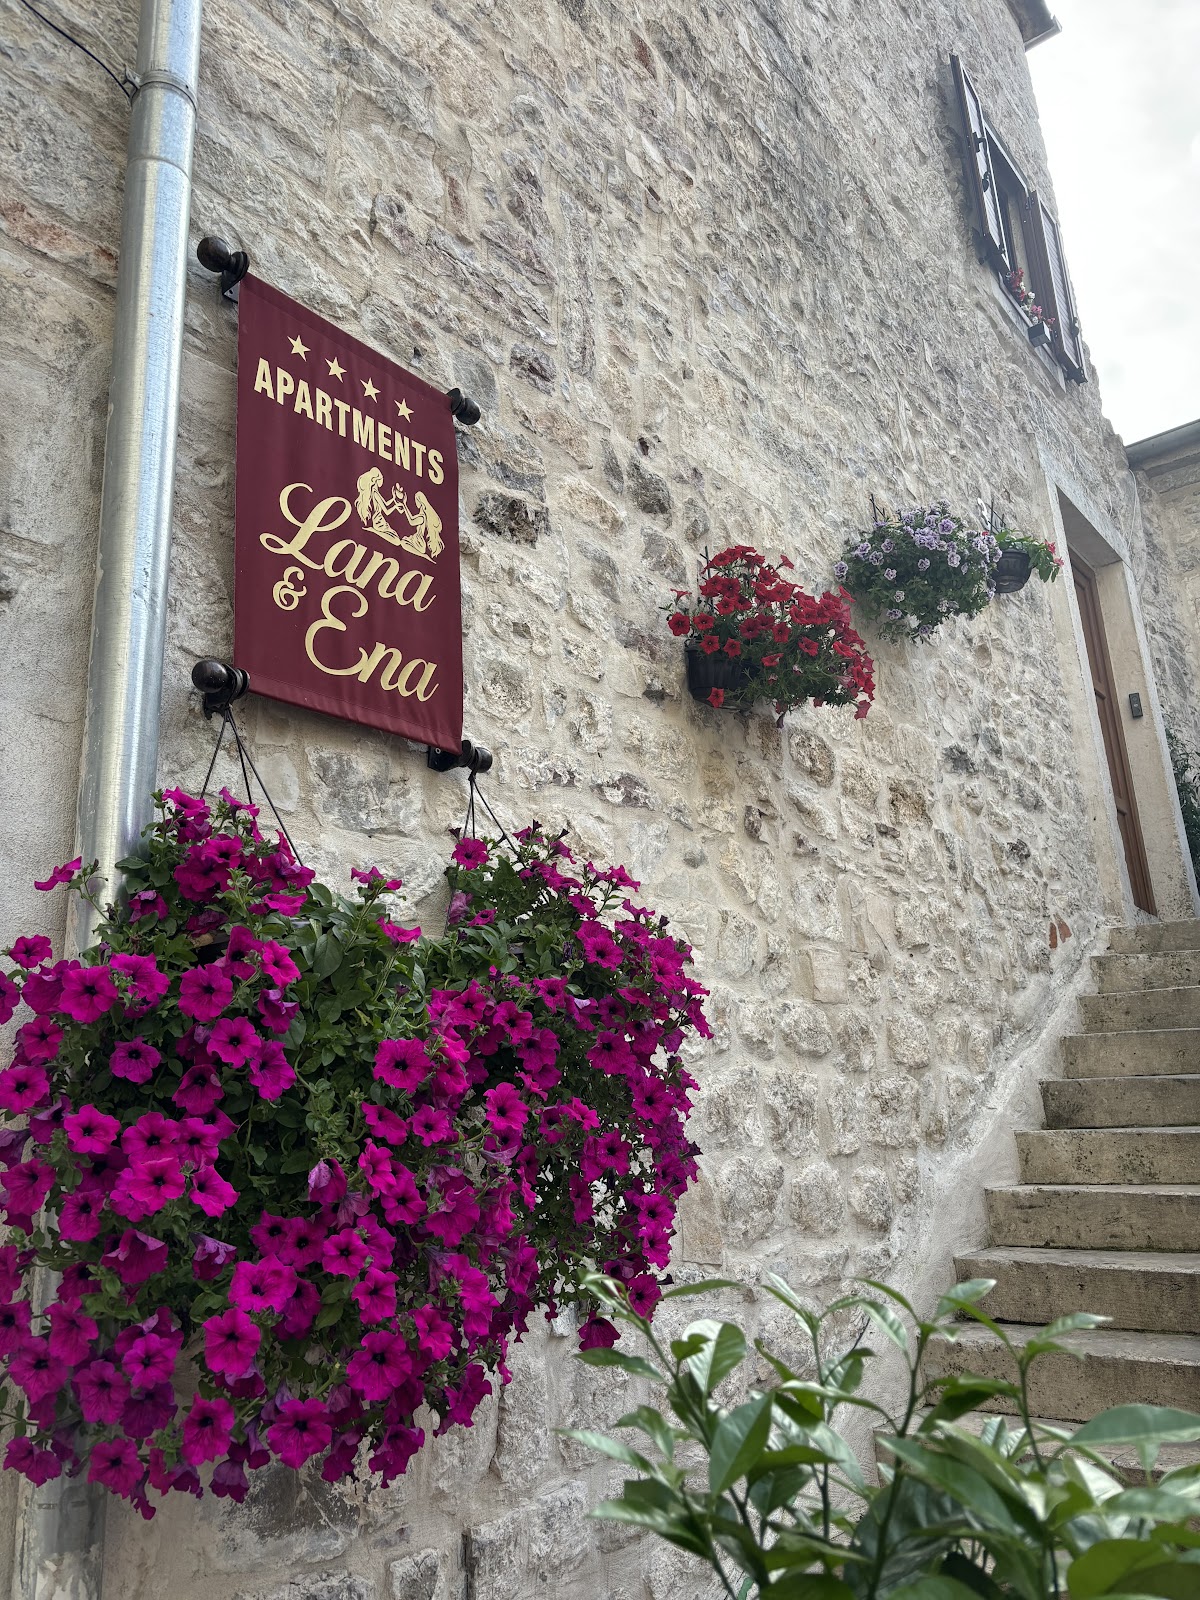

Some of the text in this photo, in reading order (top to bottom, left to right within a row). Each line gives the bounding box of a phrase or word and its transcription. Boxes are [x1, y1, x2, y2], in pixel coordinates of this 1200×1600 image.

[253, 357, 445, 485] APARTMENTS
[259, 482, 437, 612] Lana
[272, 565, 439, 702] & Ena
